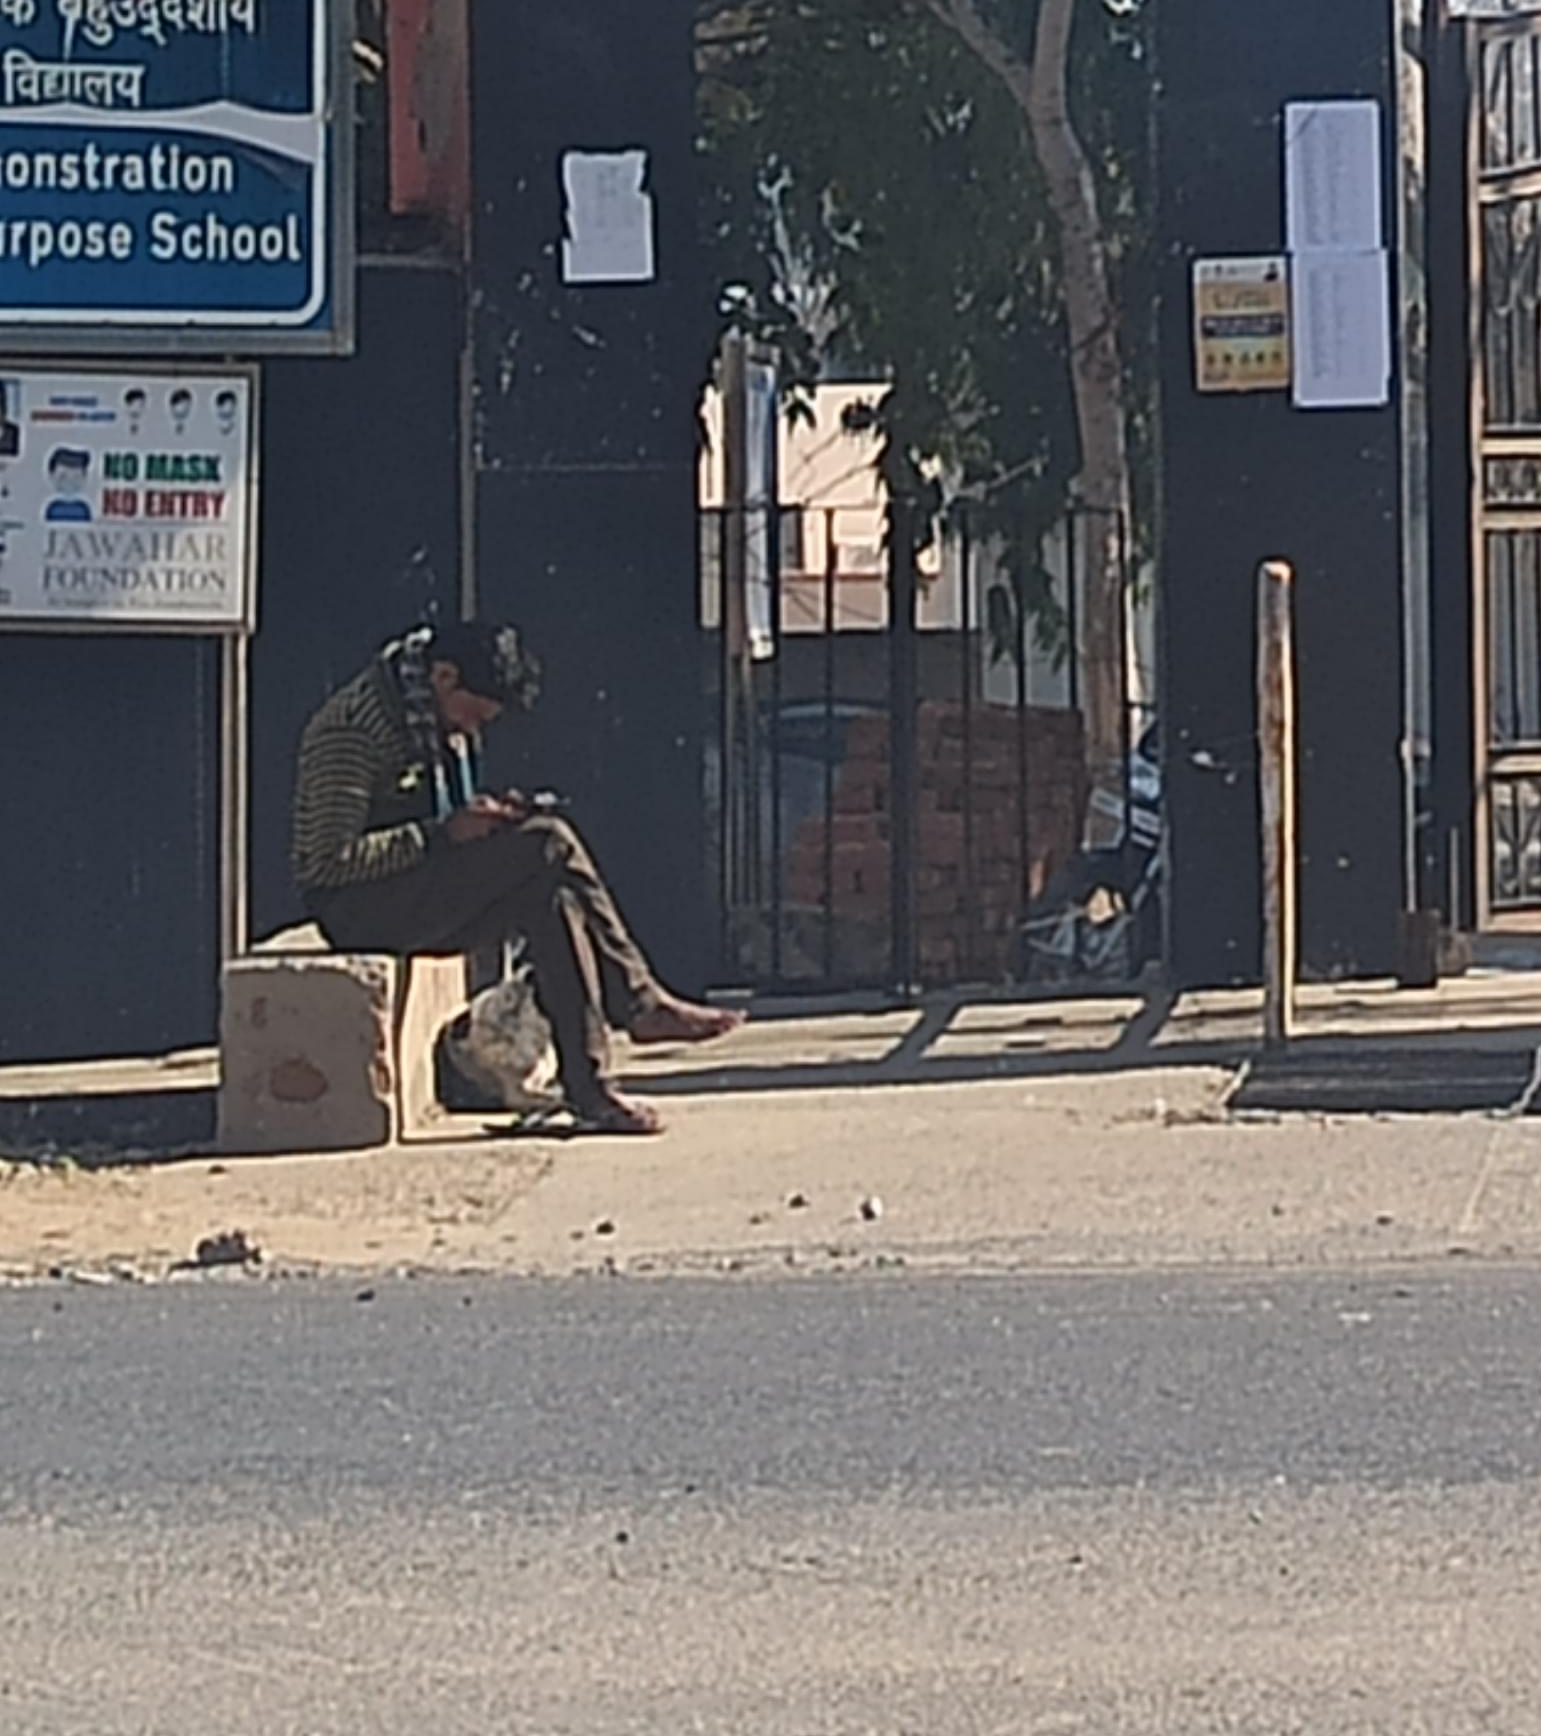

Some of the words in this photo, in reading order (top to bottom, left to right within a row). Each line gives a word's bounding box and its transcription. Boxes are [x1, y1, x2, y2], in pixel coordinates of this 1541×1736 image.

[2, 48, 146, 107] विद्यालय
[0, 142, 234, 193] onstration
[150, 212, 301, 261] School
[103, 452, 138, 481] NO
[145, 454, 222, 483] MASK
[103, 488, 137, 517] NO
[145, 489, 226, 519] ENTRY
[44, 530, 227, 562] JAWAHAR
[42, 566, 227, 593] FOUNDATION
